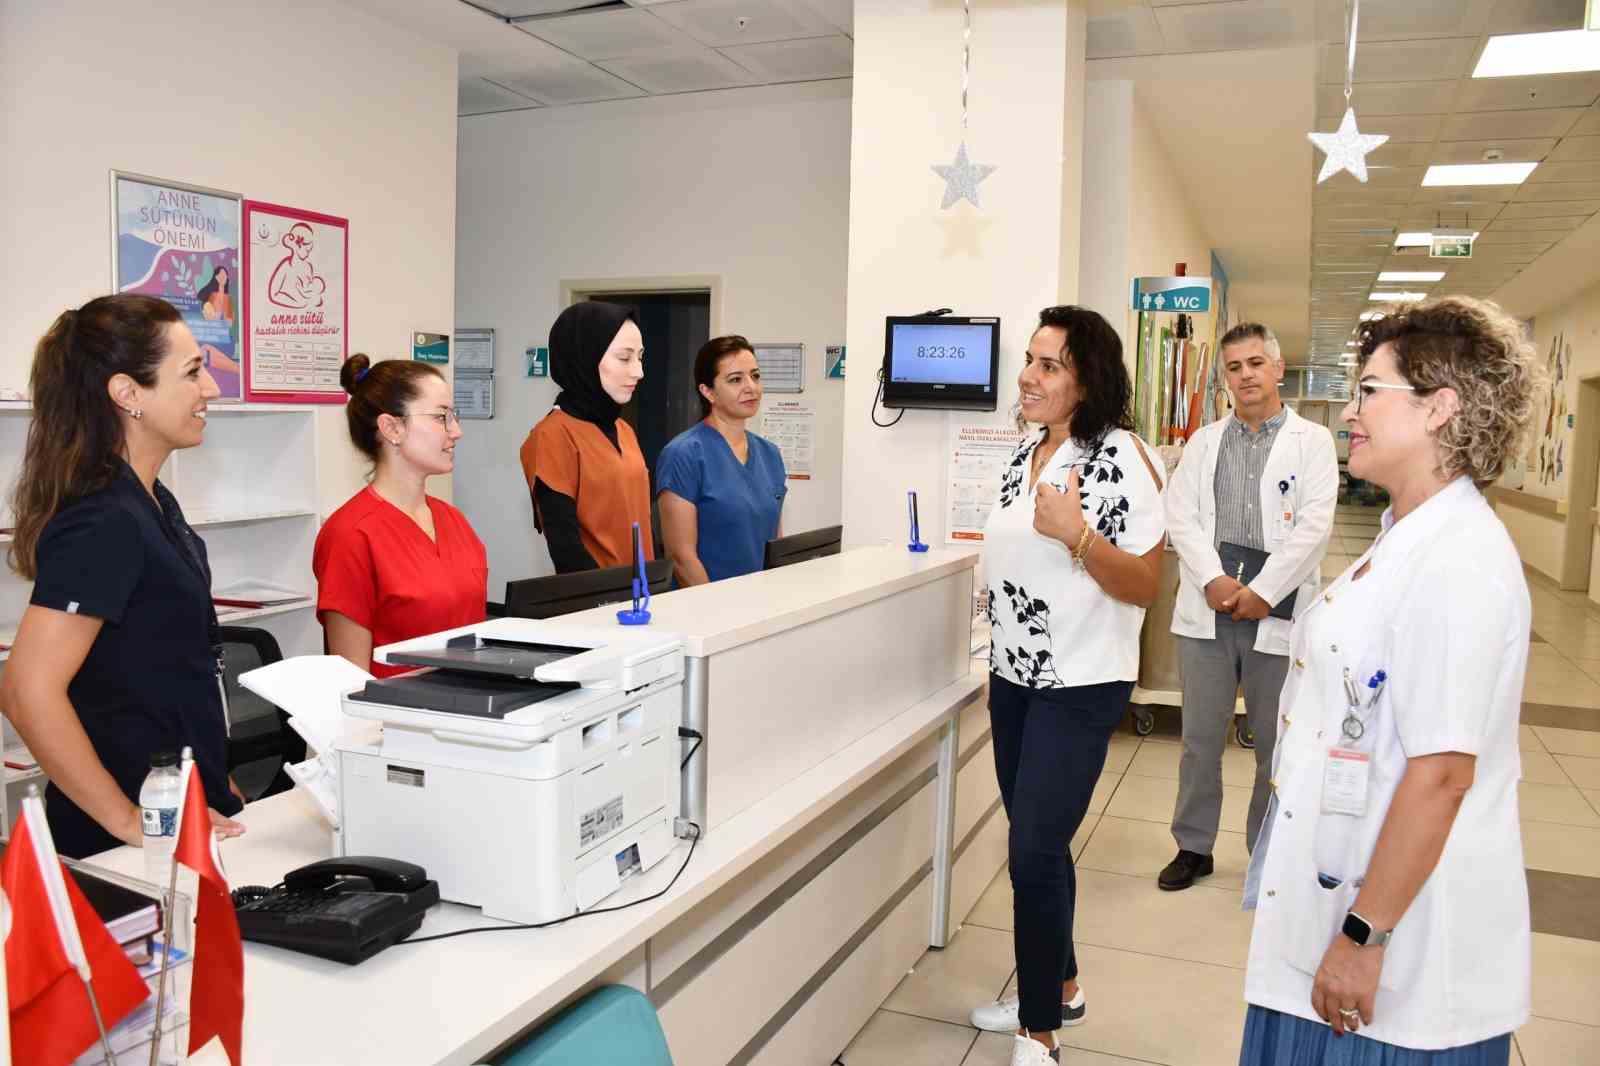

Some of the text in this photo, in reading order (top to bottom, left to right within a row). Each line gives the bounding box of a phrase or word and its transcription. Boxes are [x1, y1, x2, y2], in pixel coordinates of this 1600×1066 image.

[159, 190, 201, 211] ANNE
[1173, 296, 1200, 309] WC
[270, 314, 298, 325] anne
[917, 345, 966, 359] 8:23:26
